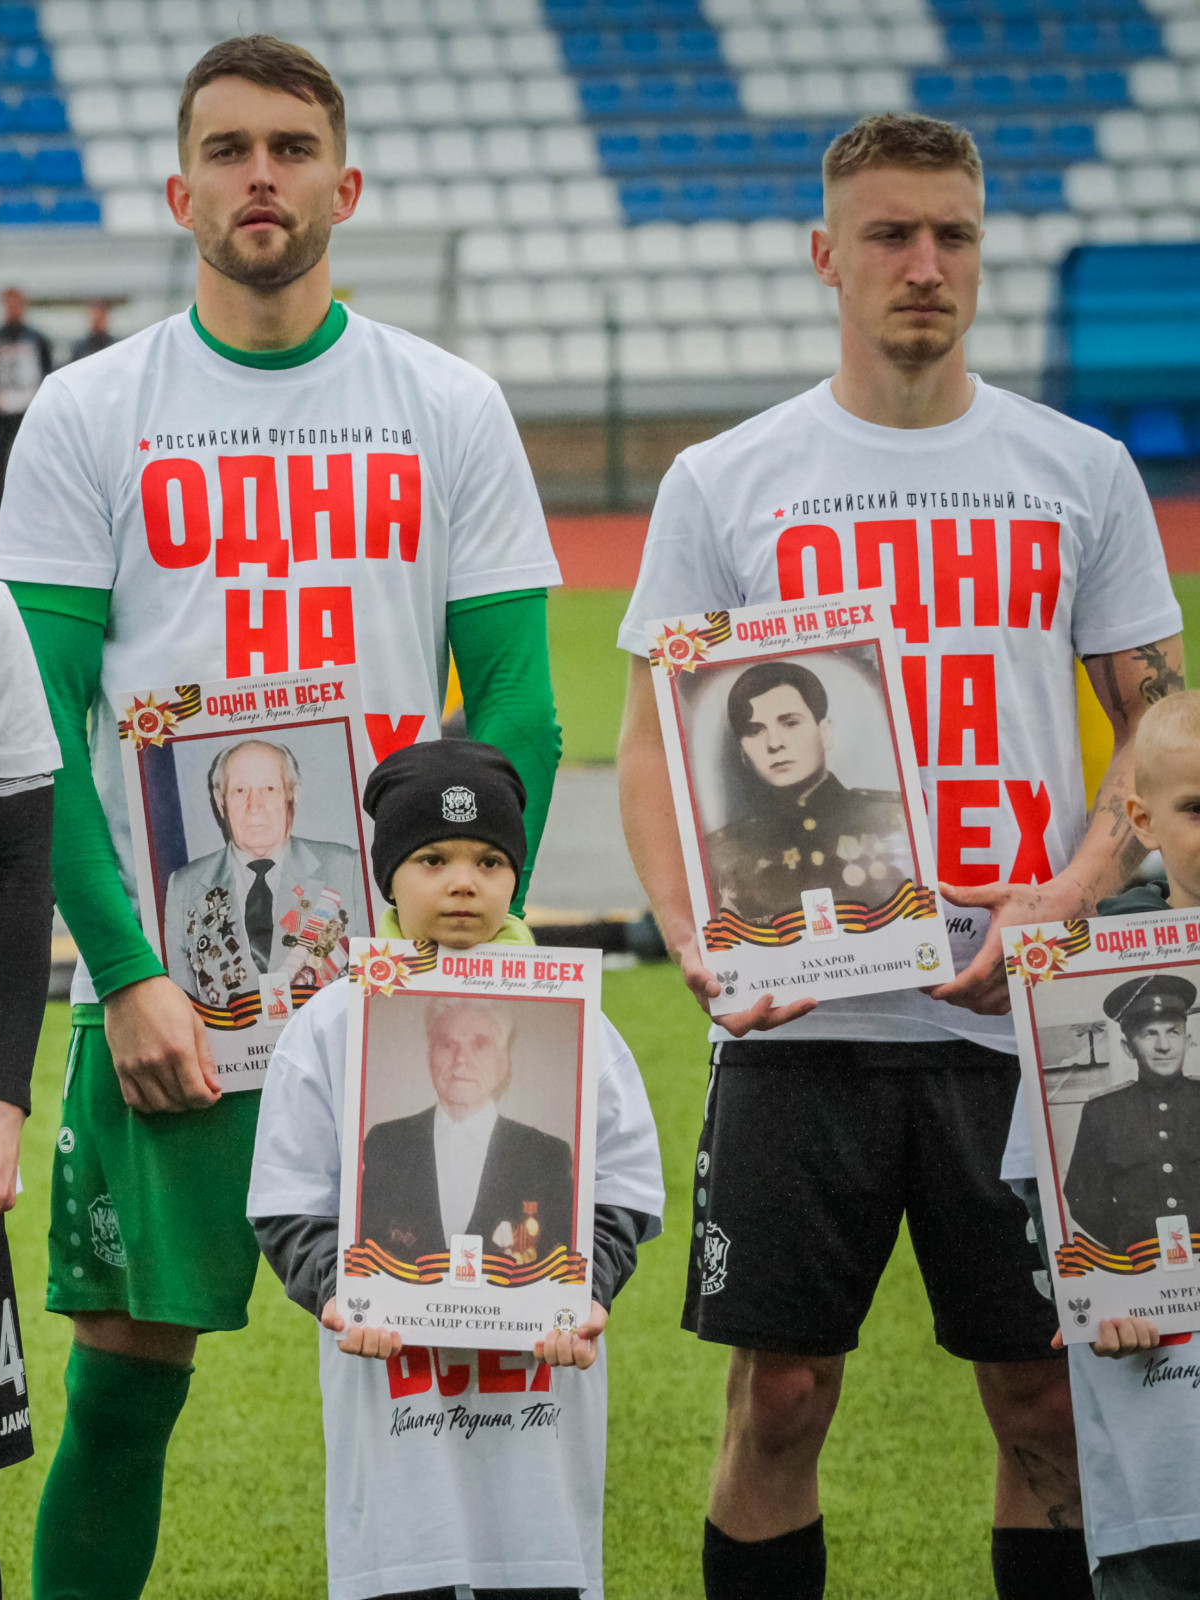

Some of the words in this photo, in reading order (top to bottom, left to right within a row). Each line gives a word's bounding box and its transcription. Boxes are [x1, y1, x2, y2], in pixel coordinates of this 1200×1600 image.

[156, 428, 261, 450] РОССИЙСКИЙ
[269, 426, 373, 446] ФУТБОЛЬНЫЙ
[382, 427, 418, 445] СОЮ
[141, 453, 421, 578] ОДНА
[792, 491, 898, 516] РОССИЙСКИЙ
[907, 492, 1015, 508] ФУТБОЛЬНЫЙ
[776, 519, 1060, 644] ОДНА
[225, 586, 356, 679] НА
[736, 617, 787, 642] ОДНА
[793, 612, 818, 633] НА
[824, 604, 874, 629] ВСЕХ
[206, 692, 257, 716] ОДНА
[264, 688, 289, 709] НА
[295, 681, 345, 705] ВСЕХ
[922, 779, 1053, 887] ЕХ
[1096, 929, 1147, 953] ОДНА
[1153, 925, 1179, 946] НА
[442, 957, 493, 978] ОДНА
[501, 960, 526, 979] НА
[534, 961, 584, 982] ВСЕХ
[749, 972, 820, 991] АЛЕКСАНДР
[823, 959, 912, 980] МИХАЙЛОВИЧ
[800, 954, 855, 970] ЗАХАРОВ
[247, 1044, 276, 1056] ВИС
[215, 1060, 268, 1074] ЕКСАНД
[1160, 1286, 1200, 1300] МУРГА
[426, 1303, 501, 1316] СЕВРЮКОВ
[1129, 1305, 1164, 1317] ИВАН
[1167, 1301, 1200, 1314] ИВАН
[383, 1315, 463, 1329] АЛЕКСАНДР
[465, 1319, 543, 1332] СЕРГЕЕВИЧ
[1143, 1356, 1200, 1389] Команд
[390, 1406, 445, 1436] Команд
[447, 1405, 515, 1440] Родина,
